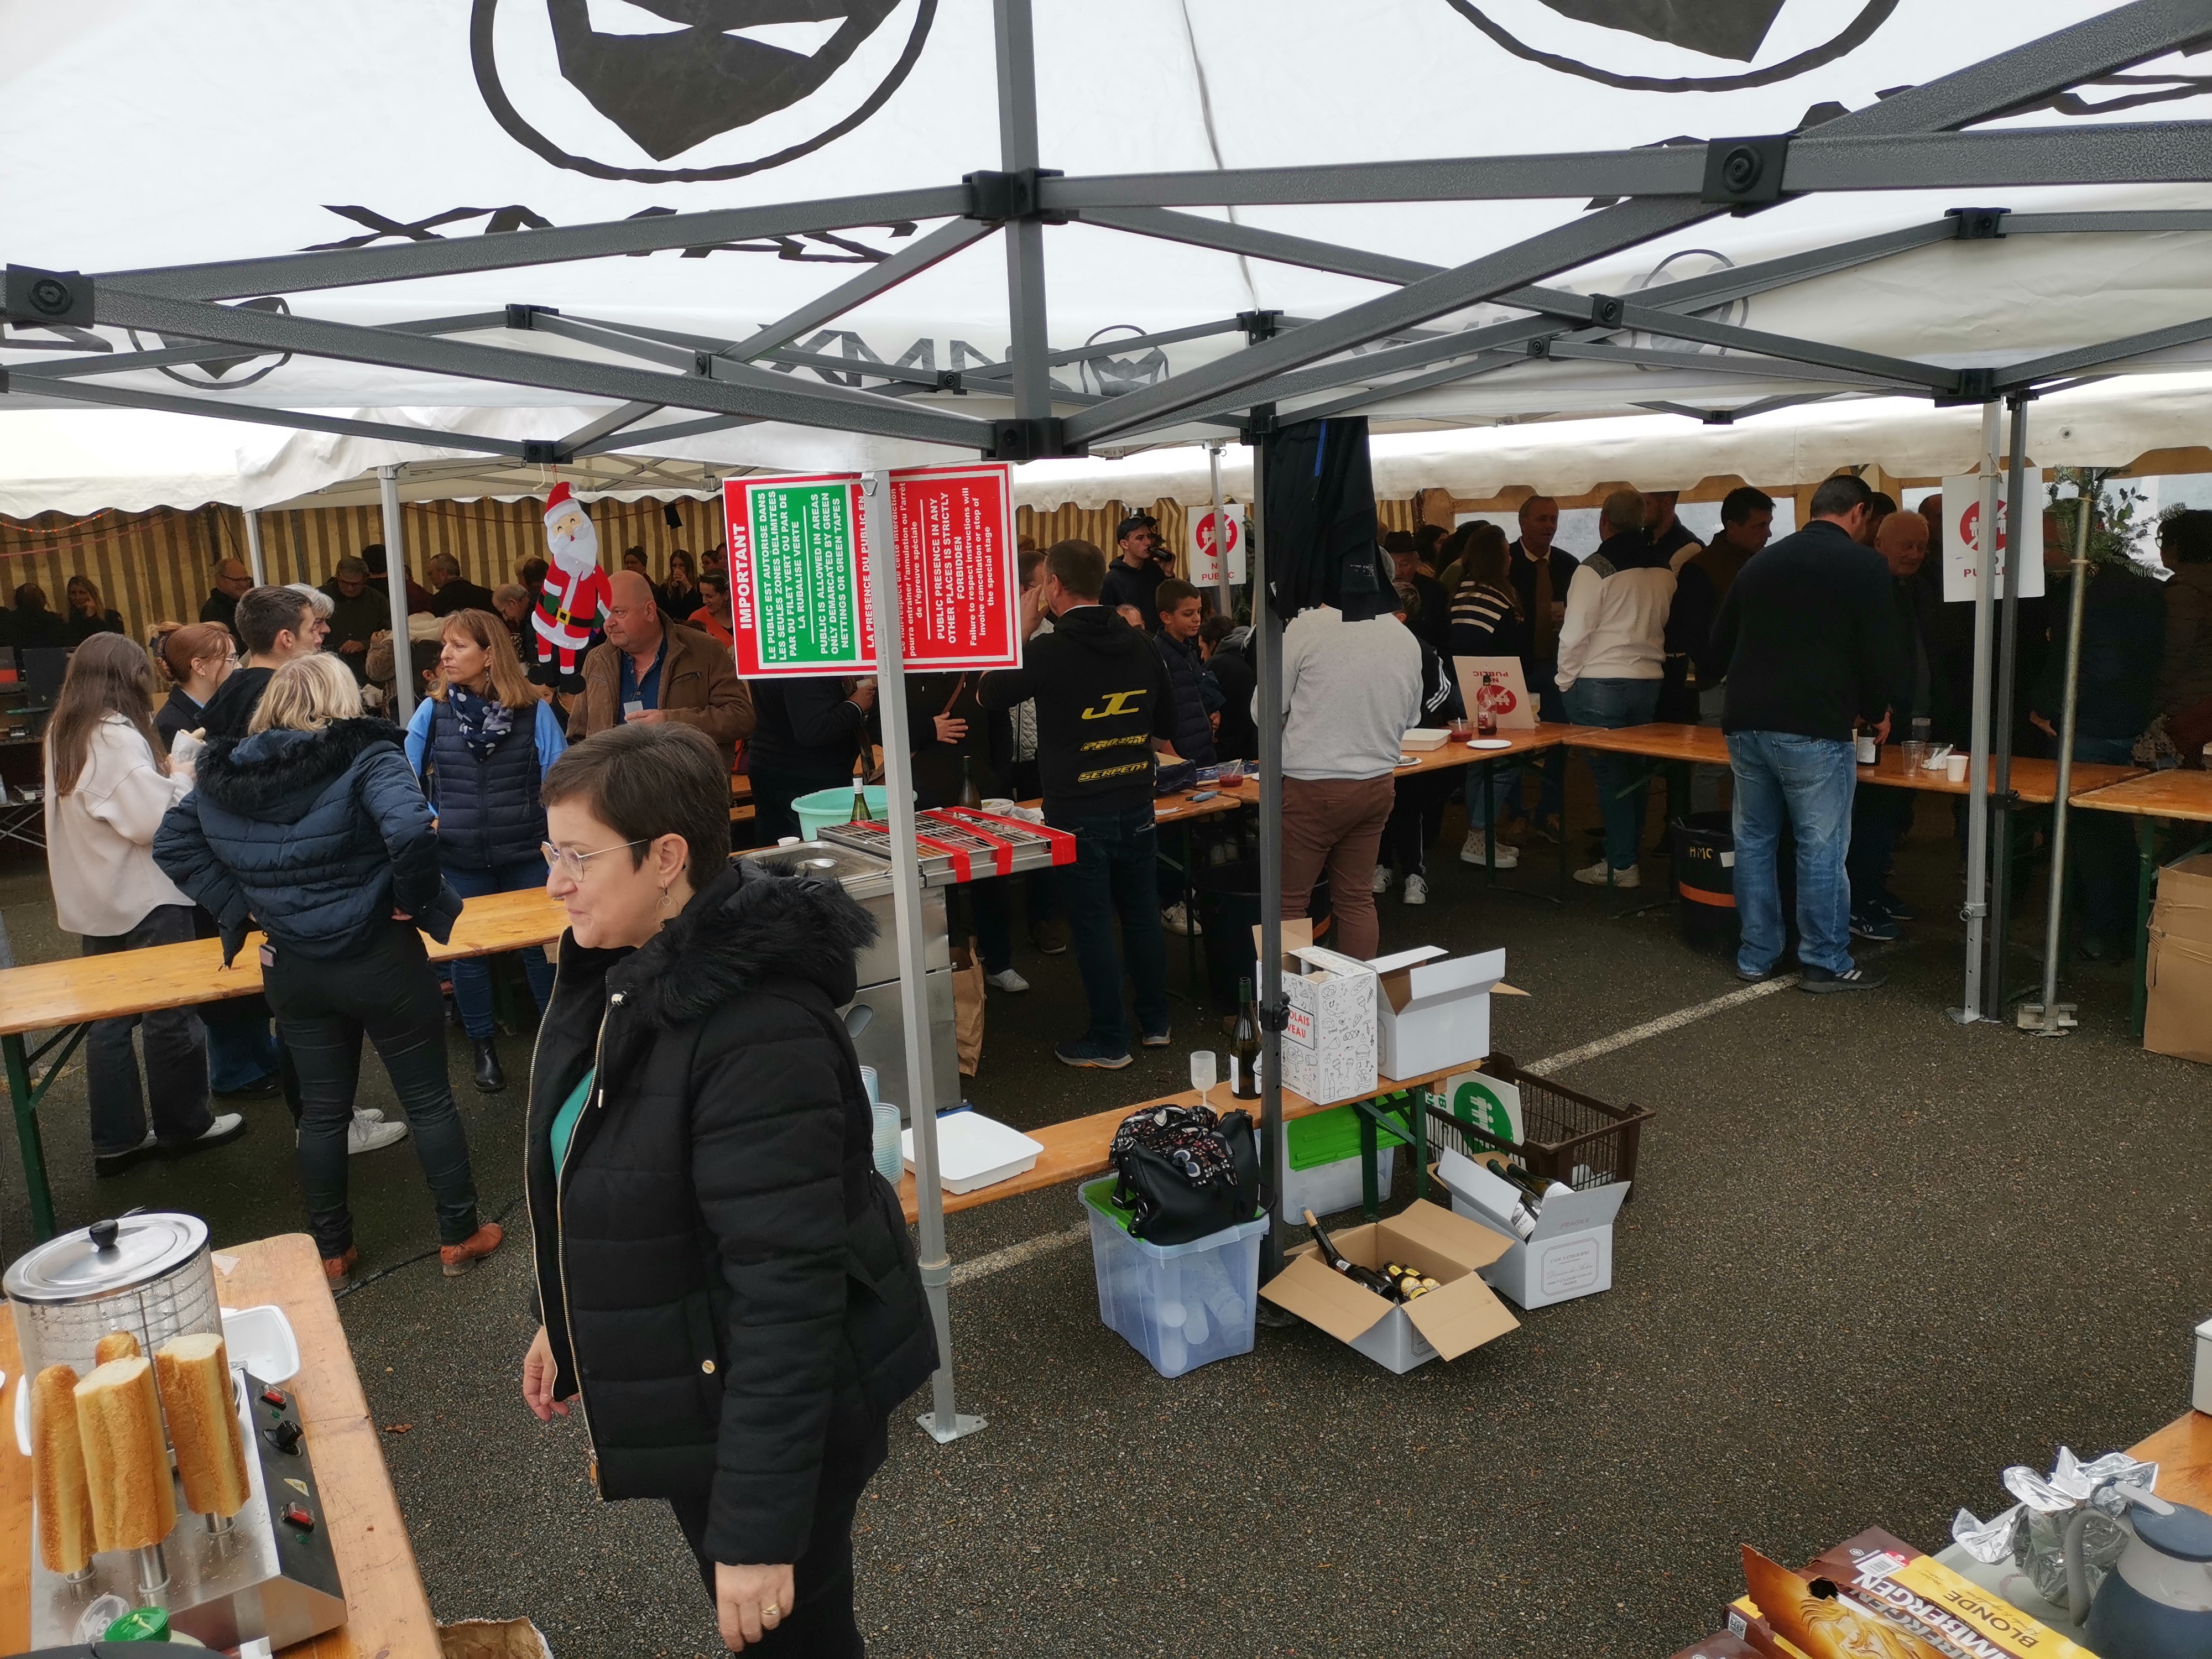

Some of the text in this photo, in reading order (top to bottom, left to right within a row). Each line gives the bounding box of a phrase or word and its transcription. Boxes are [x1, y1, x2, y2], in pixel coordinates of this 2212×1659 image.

[902, 513, 907, 525] ou
[972, 498, 979, 507] of
[911, 521, 920, 560] spéciale
[964, 507, 972, 562] instructions
[975, 532, 981, 542] or
[733, 523, 752, 629] IMPORTANT
[758, 493, 776, 659] LE PUBLIC EST AUTORISE DANS
[768, 491, 787, 660] LES SEULES ZONES DELIMITEES
[779, 494, 797, 656] PAR DU FILET VERT OU PAR DE
[791, 521, 805, 628] LA RUBALISE VERTE
[811, 494, 828, 654] PUBLIC IS ALLOWED IN AREAS
[821, 493, 838, 654] ONLY DEMARCATED BY GREEN
[832, 498, 848, 648] NETTINGS OR GREEN TAPES
[858, 495, 874, 648] LA PRESENCE DU PUBLIC EN
[930, 498, 945, 639] PUBLIC PRESENCE IN ANY
[941, 492, 956, 644] OTHER PLACES IS STRICTLY
[954, 536, 964, 599] FORBIDDEN
[966, 565, 975, 600] respect
[975, 545, 984, 602] cancellation
[985, 555, 994, 588] special
[1202, 571, 1234, 581] PUBC
[916, 607, 922, 618] de
[969, 603, 975, 612] to
[1078, 761, 1149, 782] SERPENT
[1287, 1024, 1306, 1039] VEAU
[1289, 1010, 1310, 1027] OLAIS
[1560, 1217, 1590, 1228] FRAGILE
[1730, 1618, 1744, 1631] BEER
[1851, 1574, 2010, 1659] IMBERGEN
[1942, 1590, 2040, 1649] BLONDE
